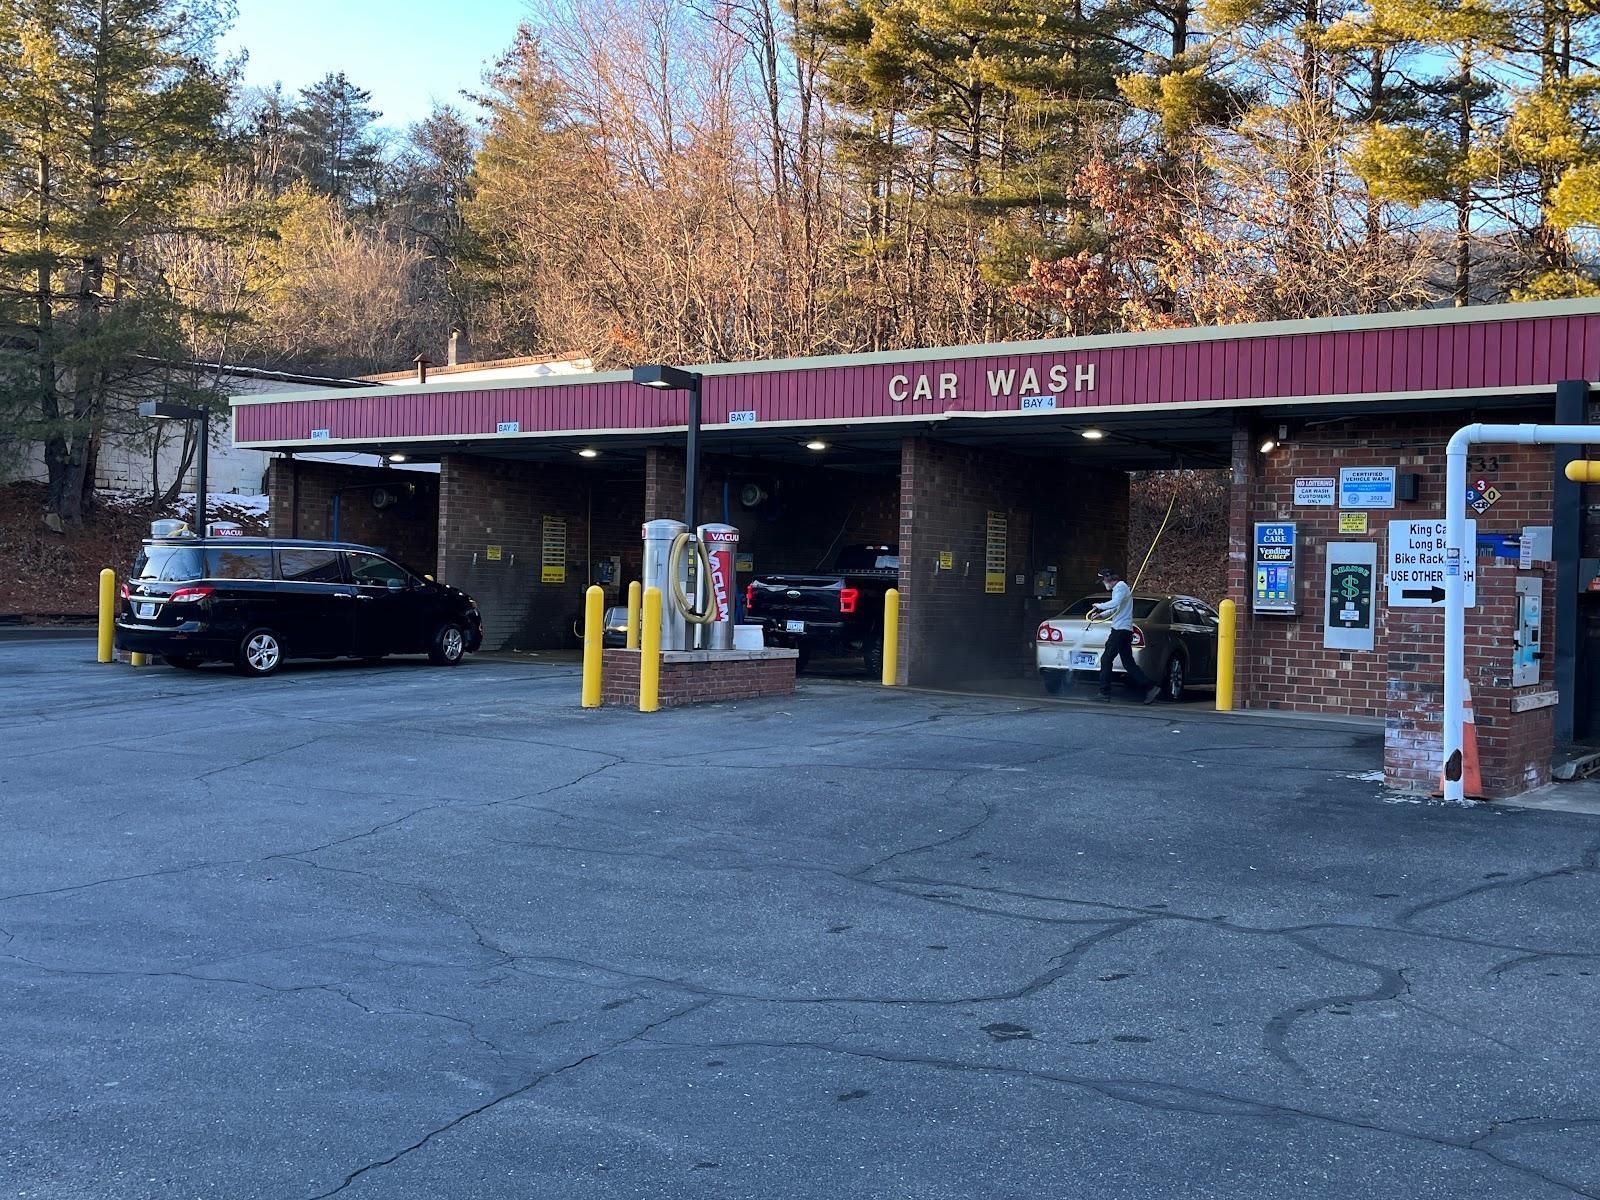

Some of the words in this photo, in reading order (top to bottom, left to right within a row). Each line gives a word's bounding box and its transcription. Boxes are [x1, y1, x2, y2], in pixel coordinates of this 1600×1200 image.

[888, 372, 958, 401] CAR
[986, 363, 1095, 396] WASH
[1023, 399, 1044, 408] BAY
[1047, 398, 1053, 407] 4
[730, 413, 746, 421] BAY
[749, 412, 754, 421] 3
[1477, 480, 1486, 491] 3
[1467, 490, 1474, 500] 3
[1488, 491, 1496, 500] 0
[1410, 523, 1432, 537] King
[1435, 523, 1447, 534] Ca
[711, 533, 739, 542] VACUU
[1263, 535, 1287, 543] CARE
[1409, 538, 1433, 551] Long
[1259, 547, 1291, 556] Vending
[1395, 553, 1416, 564] Bike
[1419, 553, 1446, 564] Rack
[1332, 565, 1370, 577] CHANGE
[1391, 571, 1409, 582] USE
[1411, 570, 1443, 582] OTHER
[708, 551, 729, 622] VACUUM
